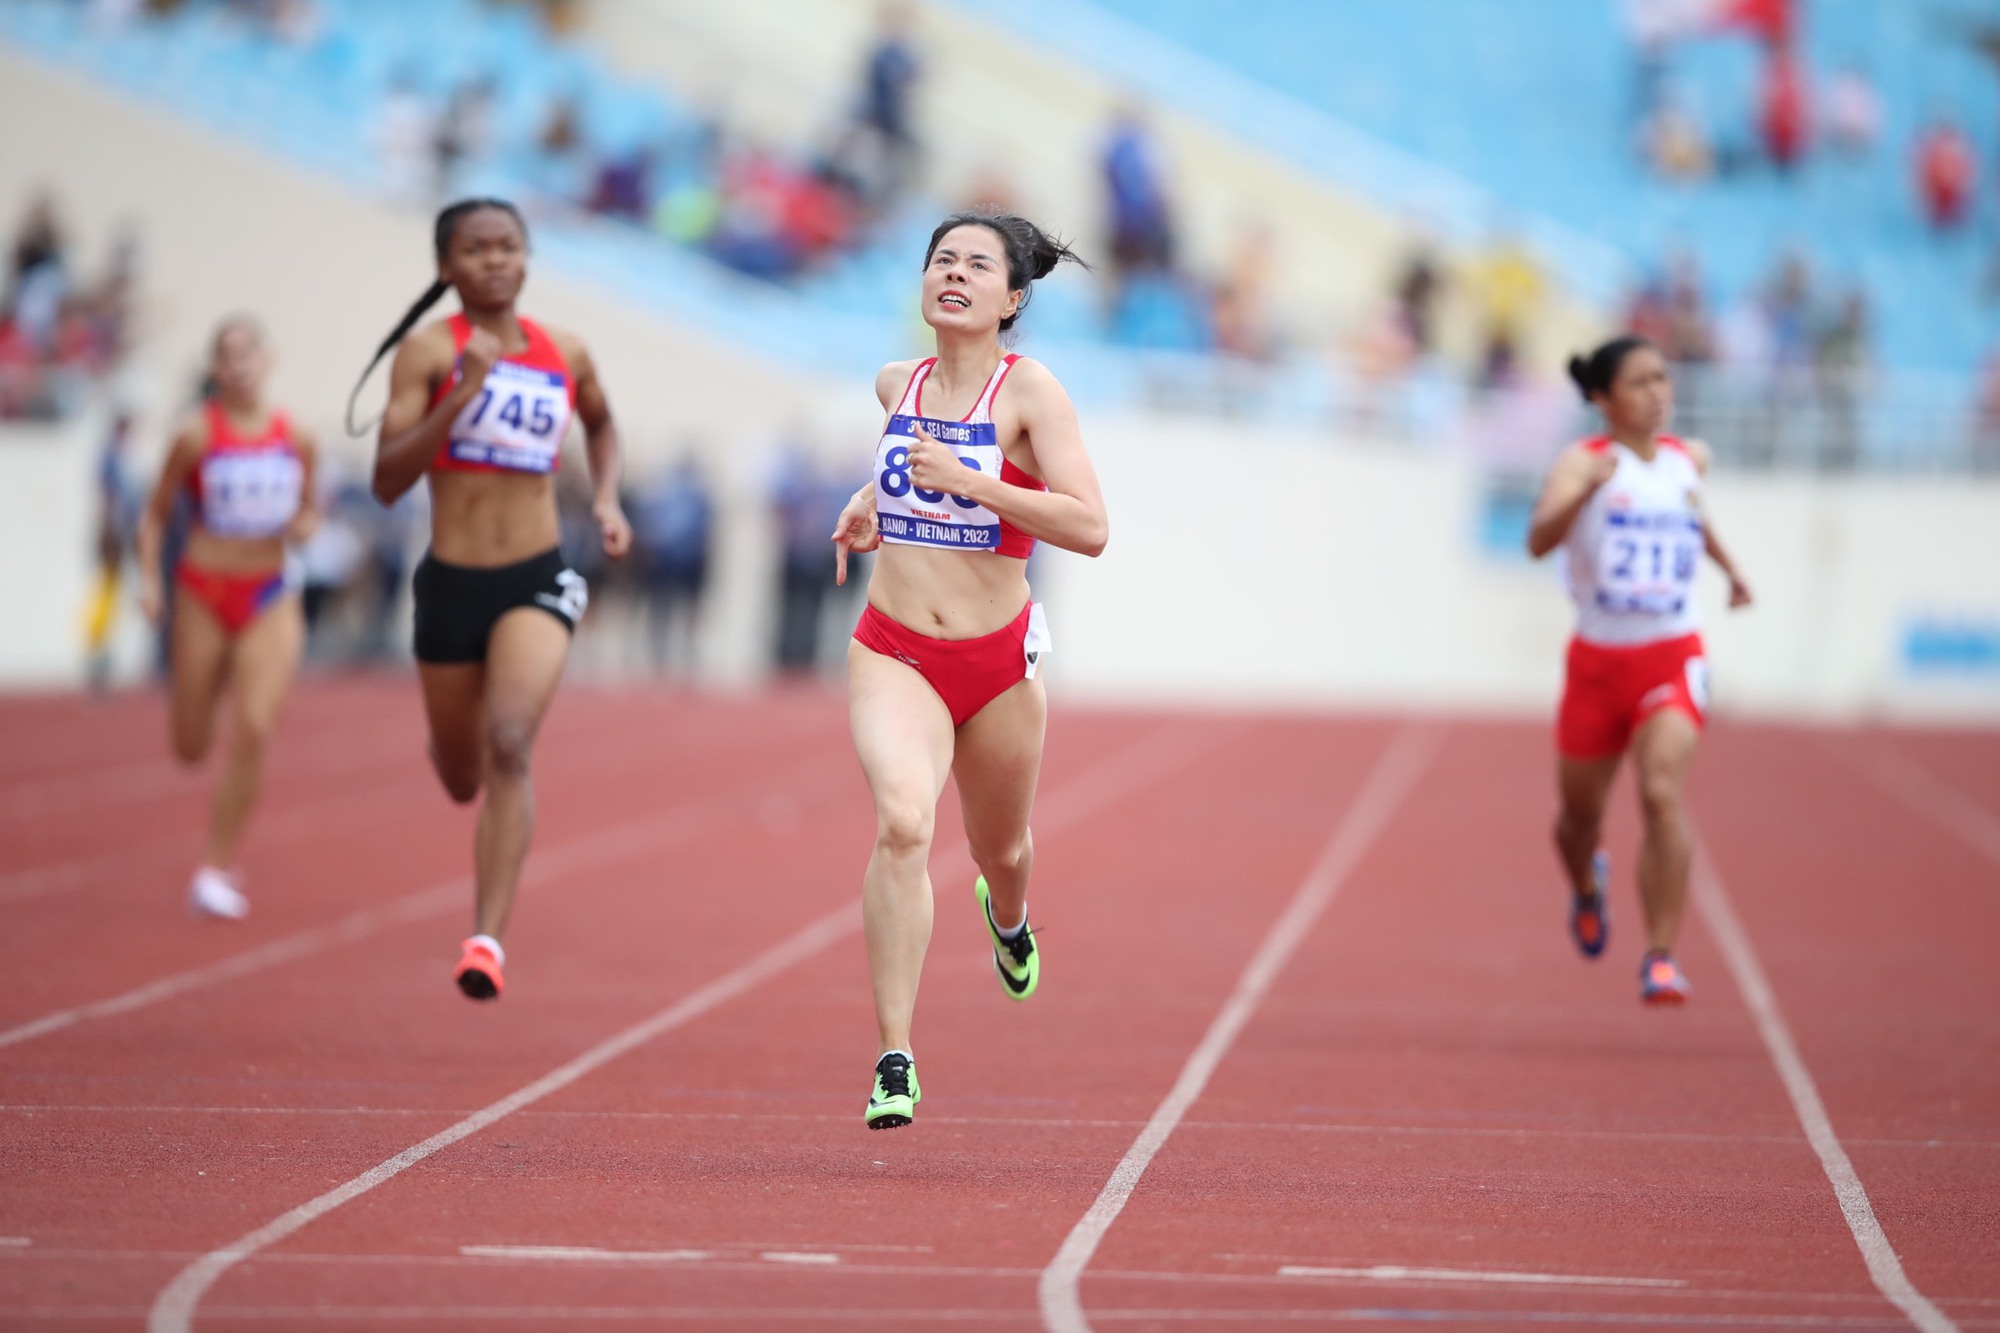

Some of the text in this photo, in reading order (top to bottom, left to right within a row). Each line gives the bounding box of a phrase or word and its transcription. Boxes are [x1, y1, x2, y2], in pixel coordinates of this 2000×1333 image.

[470, 389, 554, 438] 745
[927, 421, 941, 439] SEA
[941, 423, 970, 442] Games
[910, 508, 951, 520] VIETNAM
[882, 517, 907, 535] HANOI
[916, 522, 960, 543] VIETNAM
[963, 529, 990, 543] 2022
